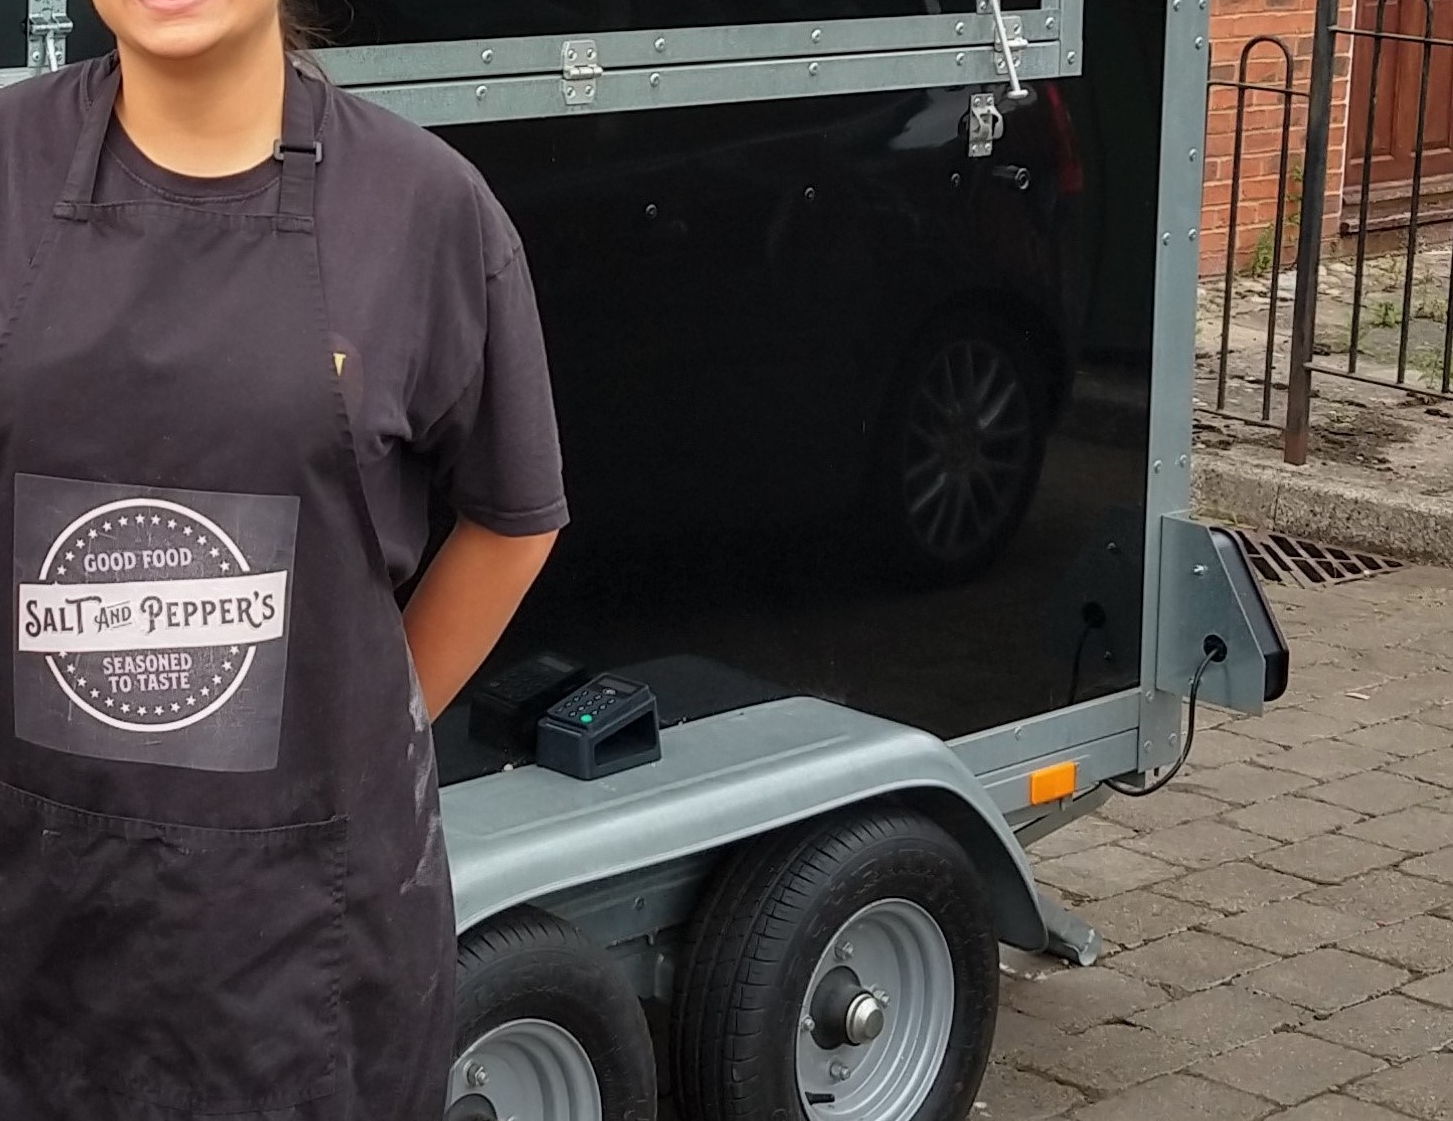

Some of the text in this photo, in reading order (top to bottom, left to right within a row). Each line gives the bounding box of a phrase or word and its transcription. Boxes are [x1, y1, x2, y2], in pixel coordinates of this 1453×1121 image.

[84, 547, 193, 572] GOOD FOOD
[25, 590, 276, 638] SALT AND PEPPER'S
[103, 653, 193, 675] SEASONED
[108, 673, 192, 694] TO TASTE
